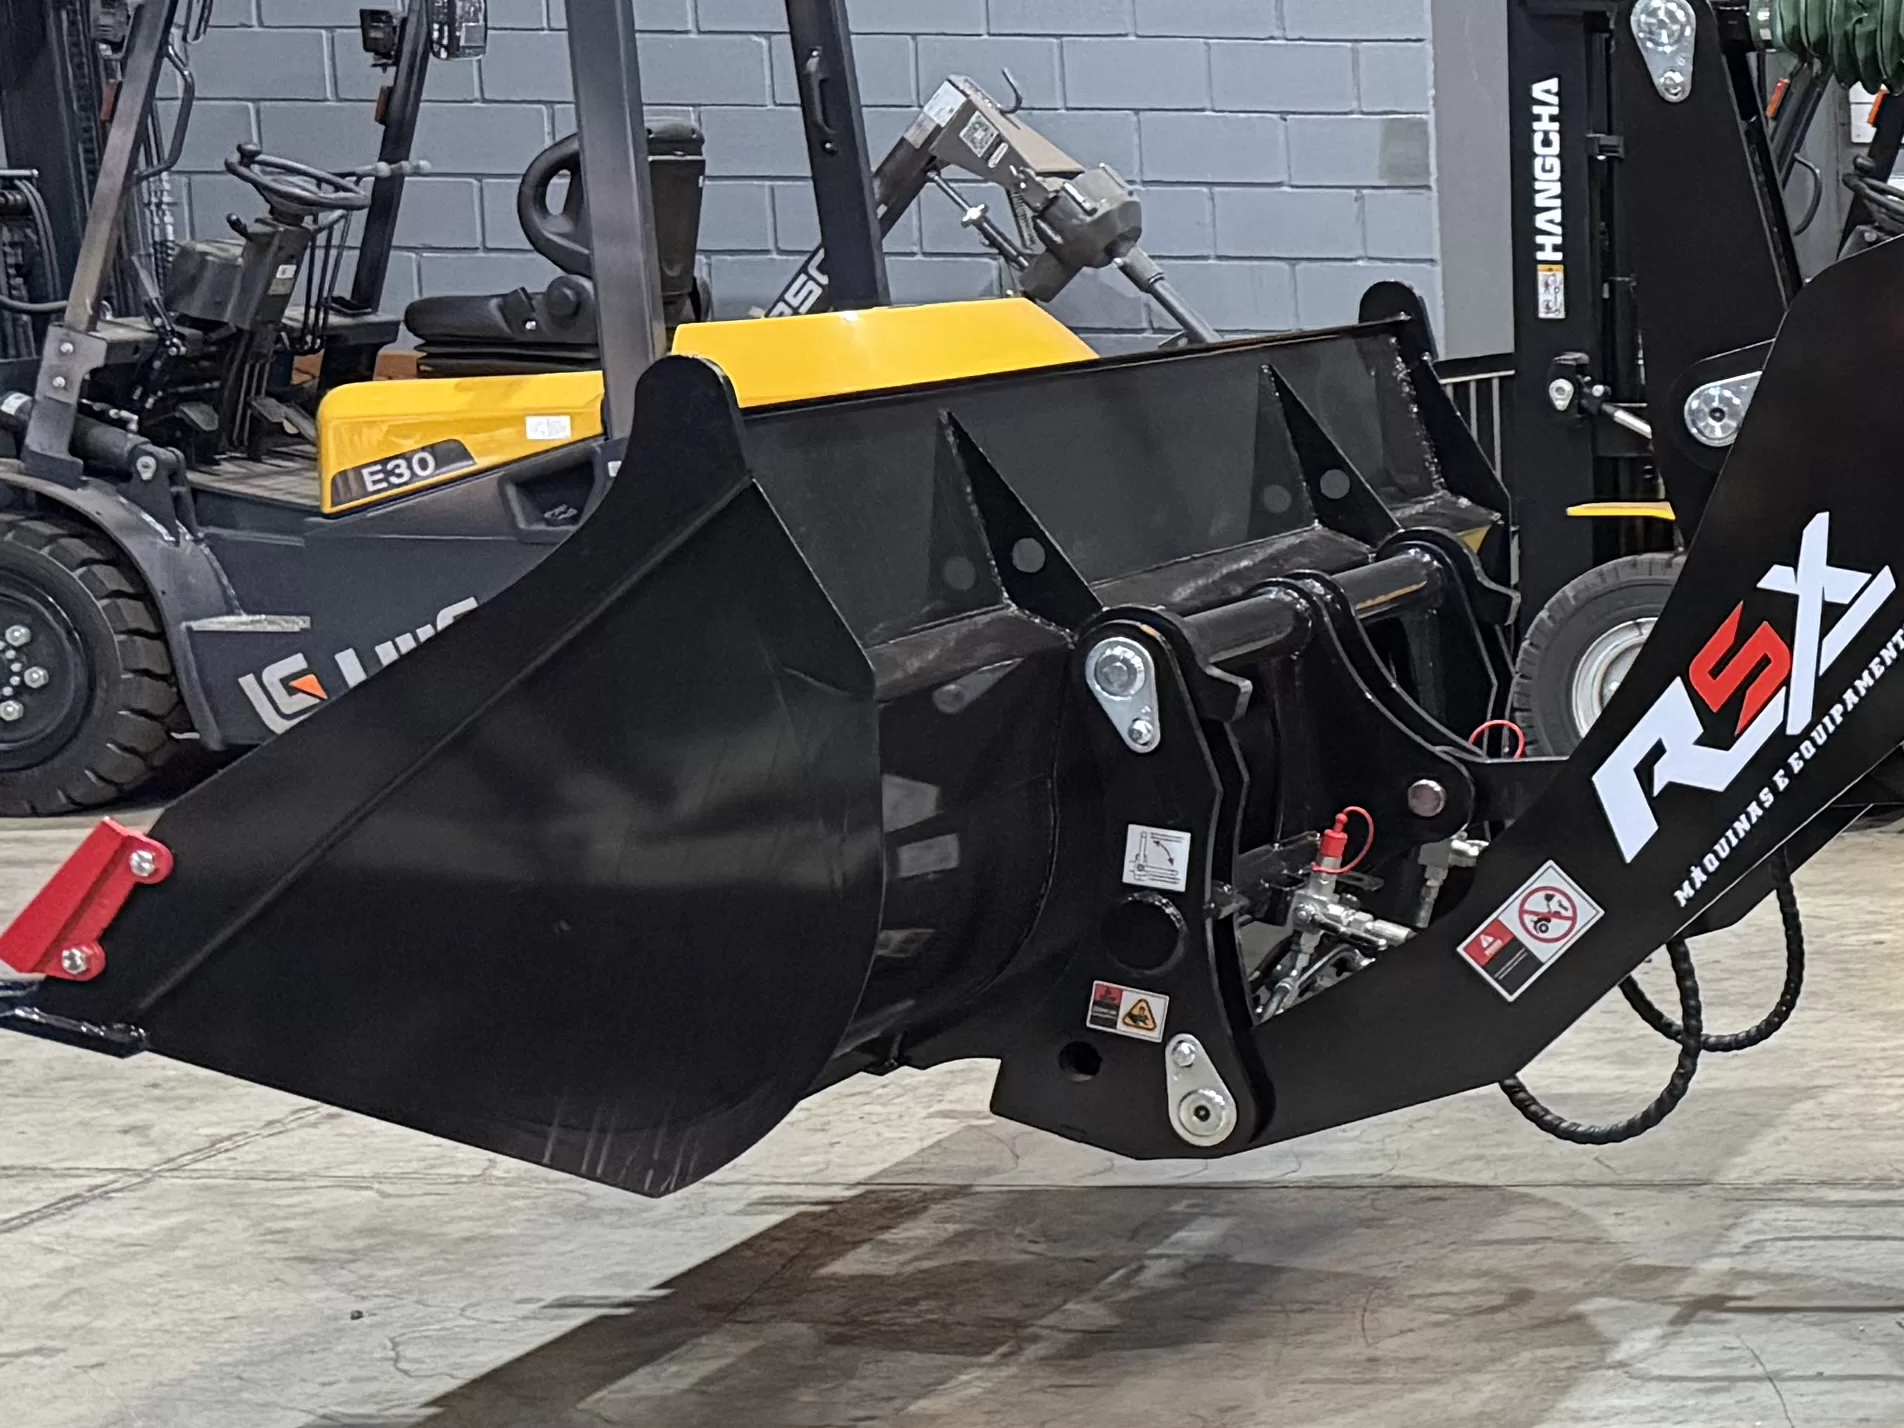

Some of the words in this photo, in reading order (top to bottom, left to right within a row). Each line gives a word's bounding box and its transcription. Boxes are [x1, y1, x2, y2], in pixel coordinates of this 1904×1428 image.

[1531, 77, 1564, 262] HANGCHA
[360, 450, 436, 493] E30
[1591, 511, 1897, 864] RSX
[1772, 768, 1790, 792] E
